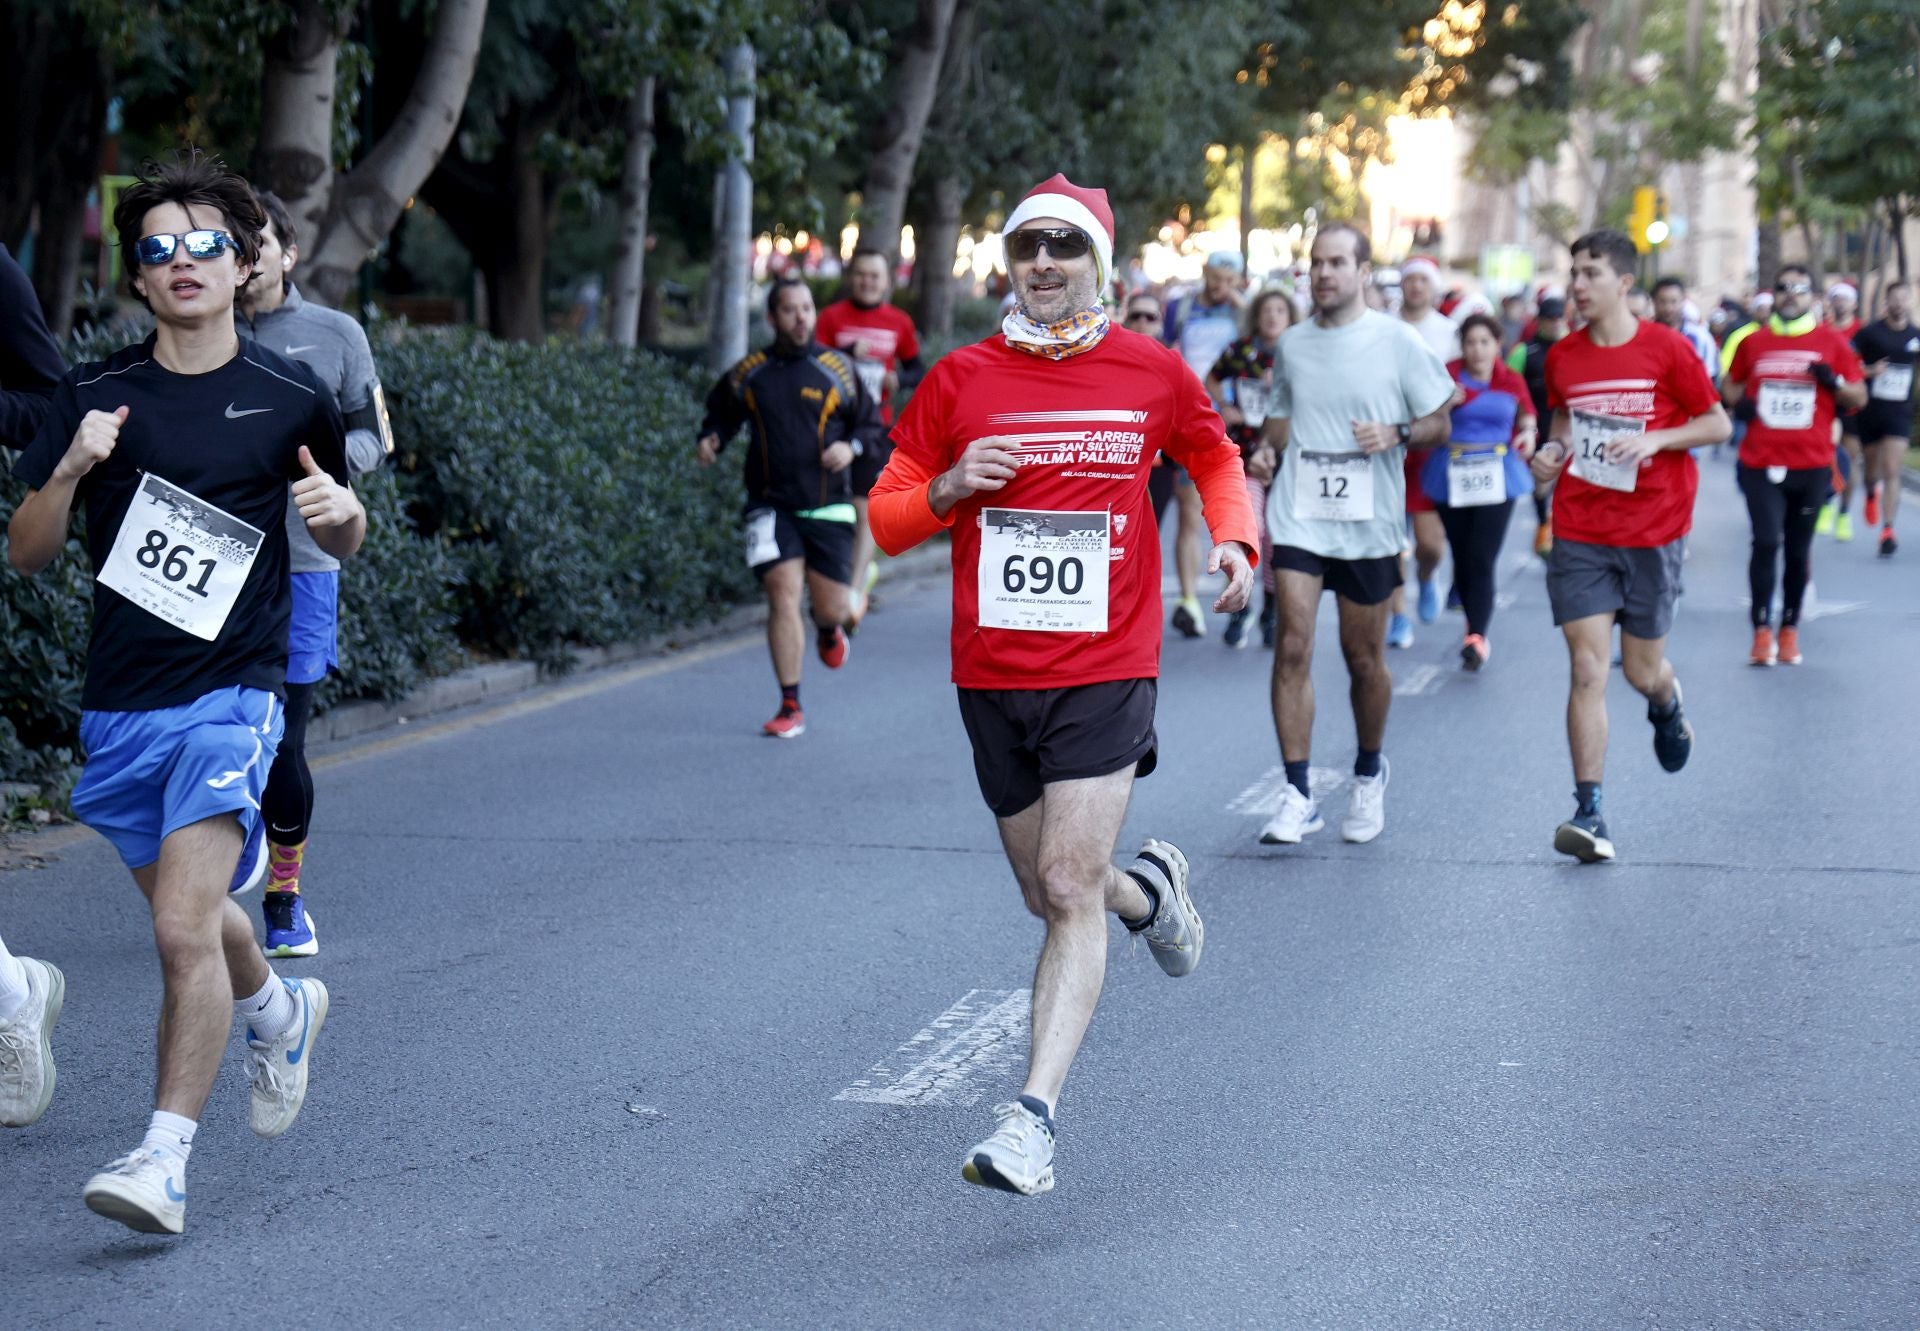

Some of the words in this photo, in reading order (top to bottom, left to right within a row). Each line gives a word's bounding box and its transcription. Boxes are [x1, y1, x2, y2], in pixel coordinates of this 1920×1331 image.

[1129, 410, 1148, 423] XIV
[1082, 431, 1144, 444] CARRERA
[1059, 442, 1084, 451] SAN
[1086, 442, 1143, 453] SILVESTRE
[1582, 438, 1604, 463] 14
[1026, 453, 1074, 464] PALMA
[1078, 452, 1140, 464] PALMILLA
[1319, 477, 1349, 498] 12
[1066, 529, 1106, 538] XIV
[137, 530, 217, 598] 861
[1003, 555, 1083, 595] 690
